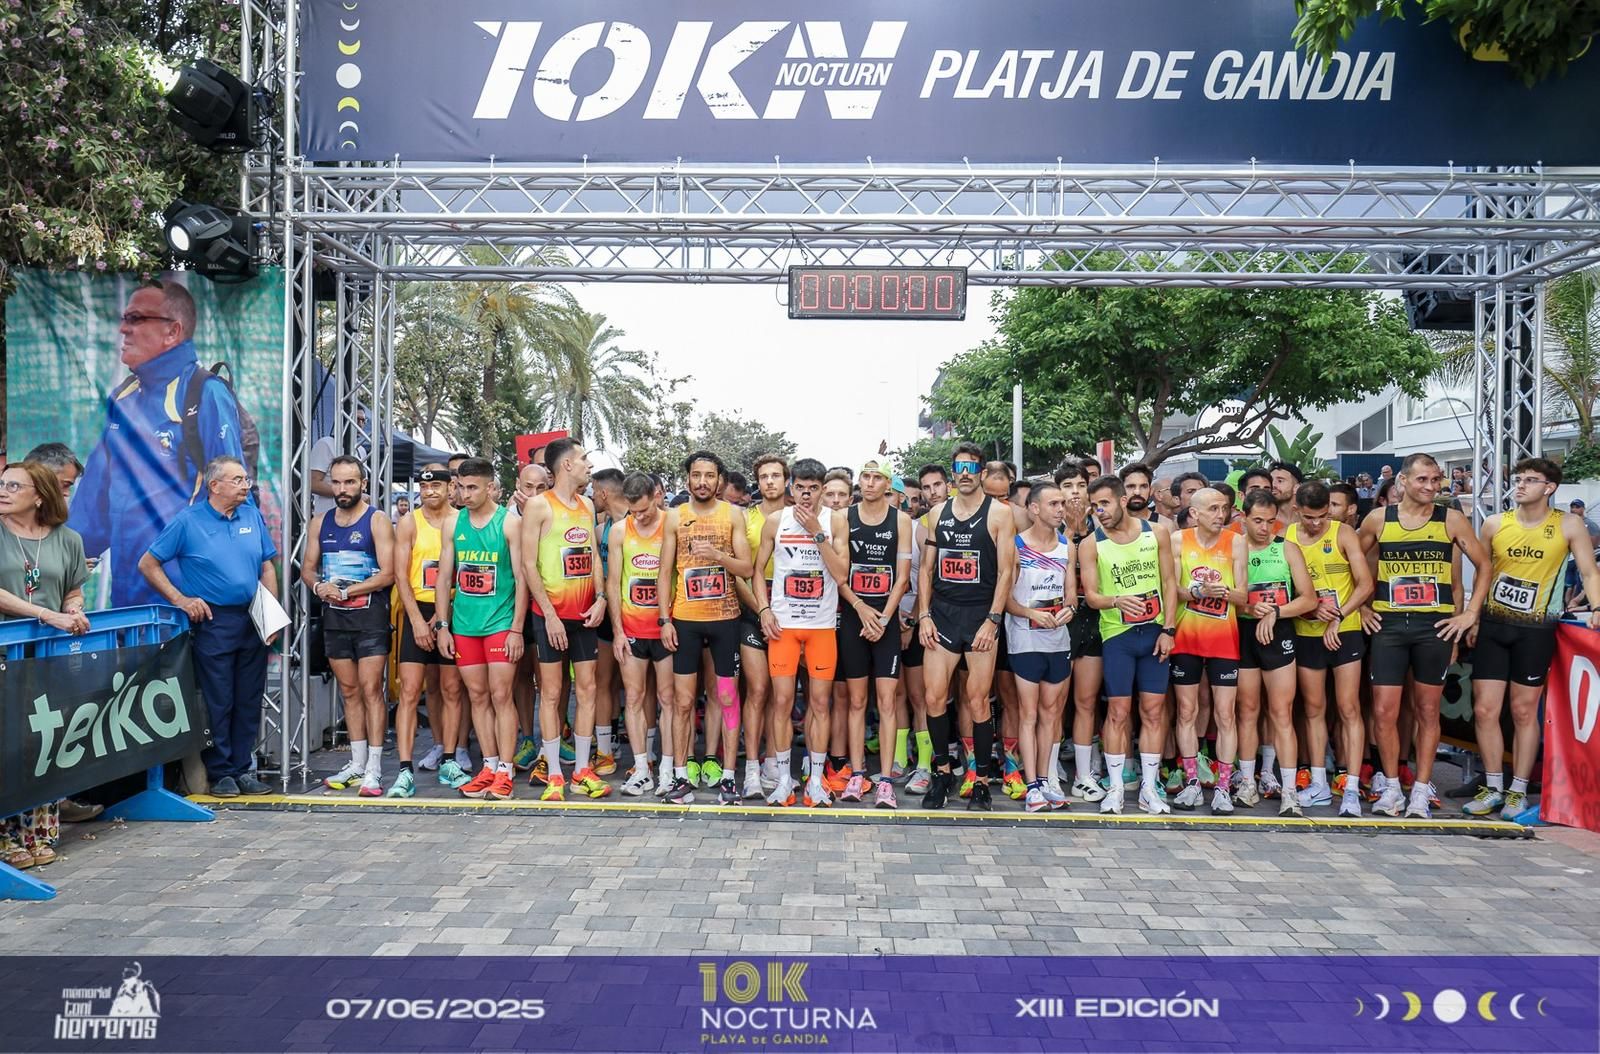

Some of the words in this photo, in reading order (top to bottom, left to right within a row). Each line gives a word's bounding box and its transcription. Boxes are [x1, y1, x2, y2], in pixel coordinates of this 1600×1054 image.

[776, 62, 894, 87] NOCTURN
[920, 49, 1103, 99] PLATJA
[1115, 50, 1195, 100] DE
[1203, 49, 1397, 101] GANDIA
[864, 543, 888, 551] VICKY
[1507, 545, 1545, 559] teika
[945, 560, 972, 574] 3148
[465, 574, 484, 588] 185
[690, 577, 721, 593] 3144
[794, 580, 814, 593] 193
[861, 575, 881, 589] 176
[1404, 586, 1424, 600] 151
[1500, 585, 1528, 604] 3418
[28, 671, 192, 778] teika
